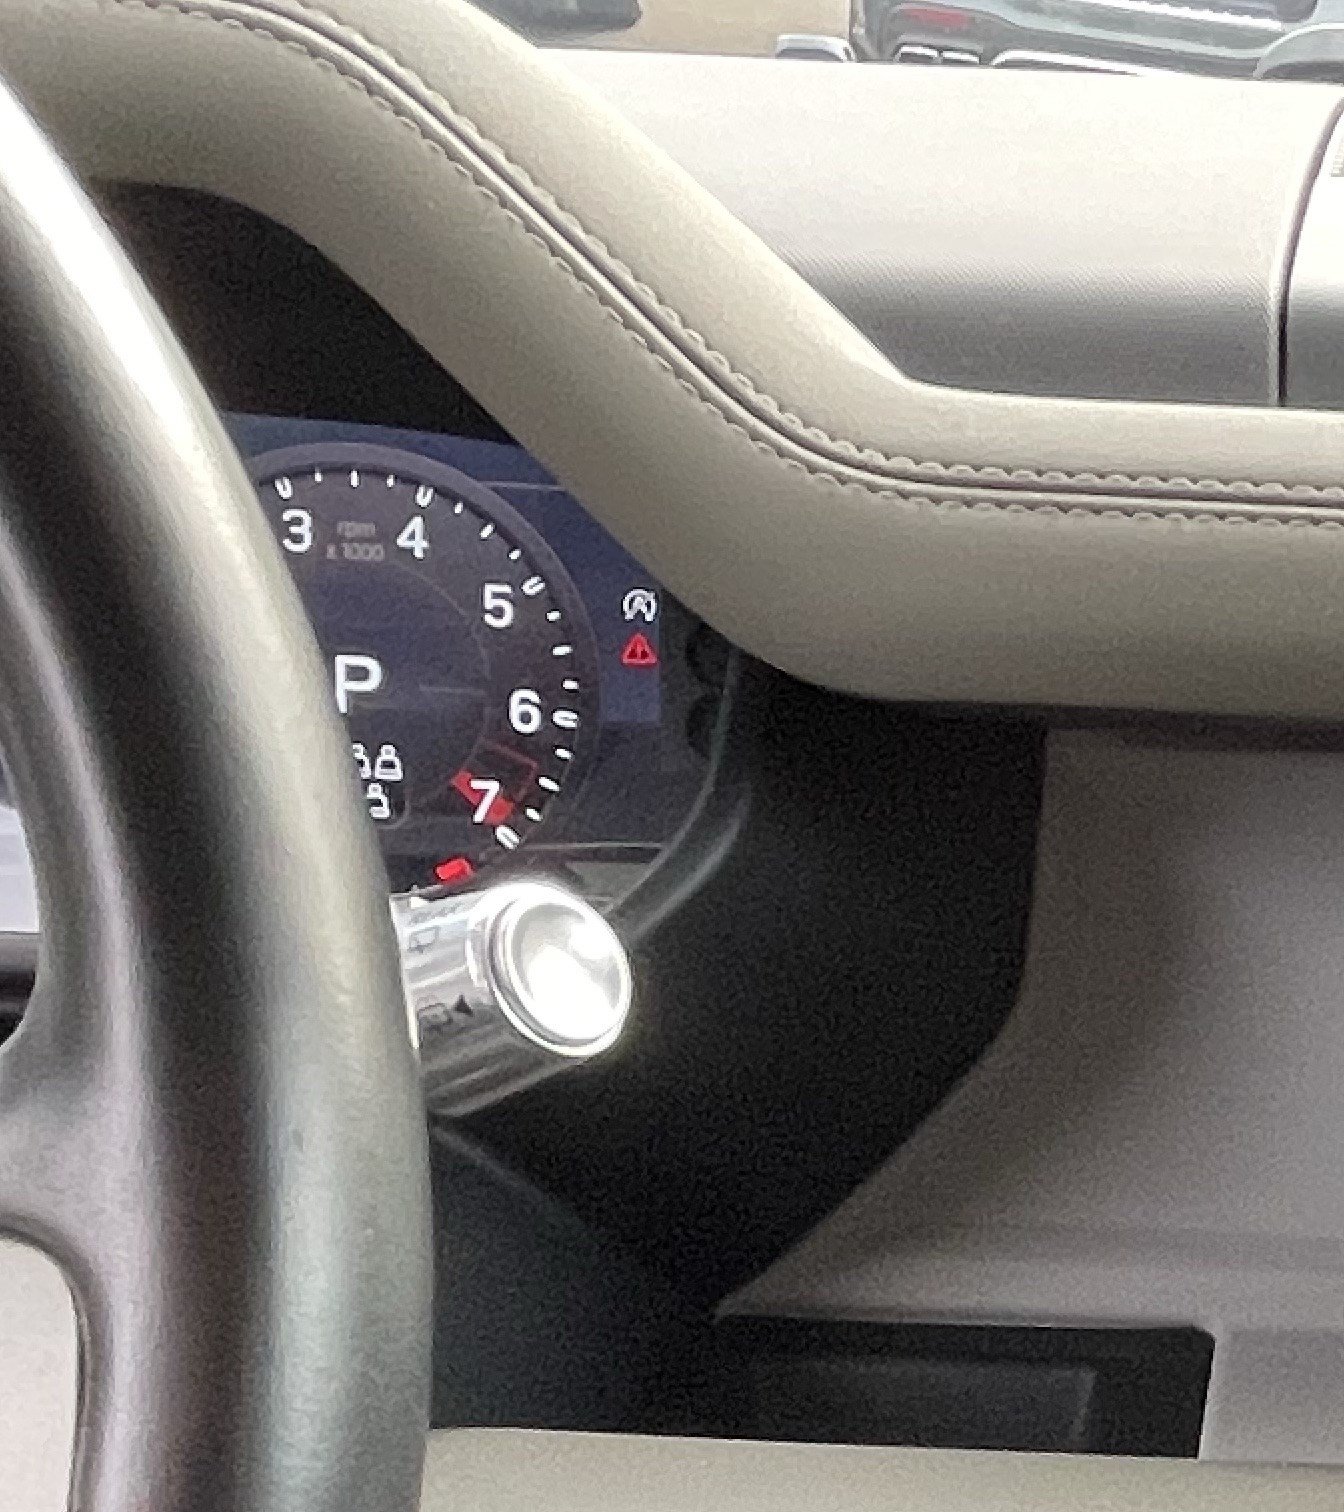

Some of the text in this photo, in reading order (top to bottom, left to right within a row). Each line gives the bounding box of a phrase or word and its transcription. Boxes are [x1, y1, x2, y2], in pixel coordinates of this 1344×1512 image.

[281, 508, 313, 554] 3
[396, 515, 430, 560] 4
[482, 583, 515, 629] 5
[334, 654, 383, 714] P
[507, 689, 542, 734] 6
[469, 779, 502, 825] 7
